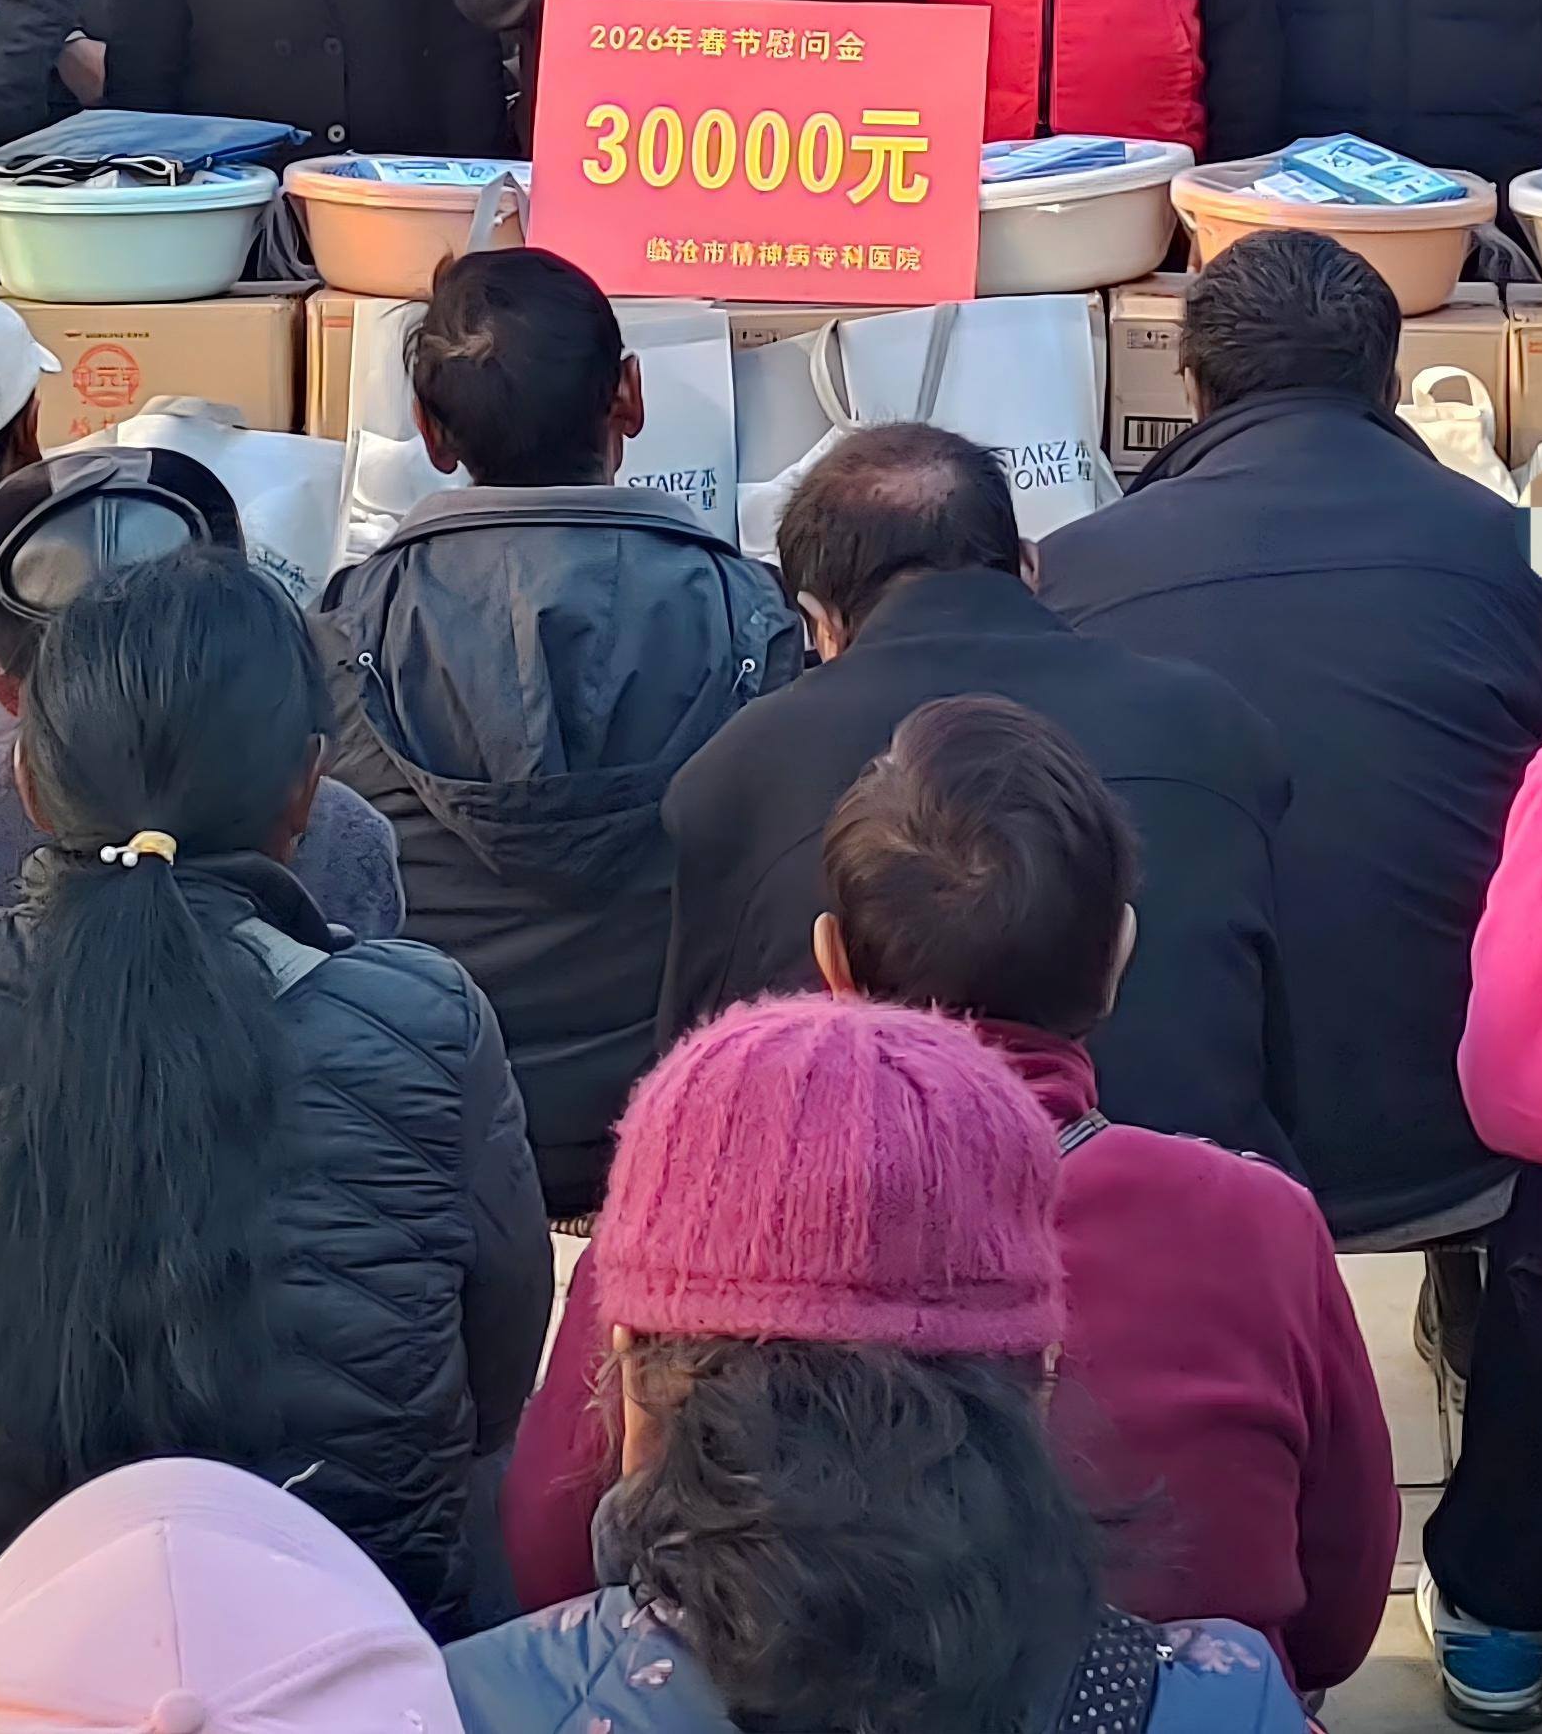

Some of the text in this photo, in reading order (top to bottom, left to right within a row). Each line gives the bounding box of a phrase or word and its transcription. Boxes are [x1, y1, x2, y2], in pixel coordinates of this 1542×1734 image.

[589, 24, 867, 62] 2026年春节慰问金
[581, 103, 931, 205] 30000元
[645, 236, 923, 272] 临沧市精神病专科医院
